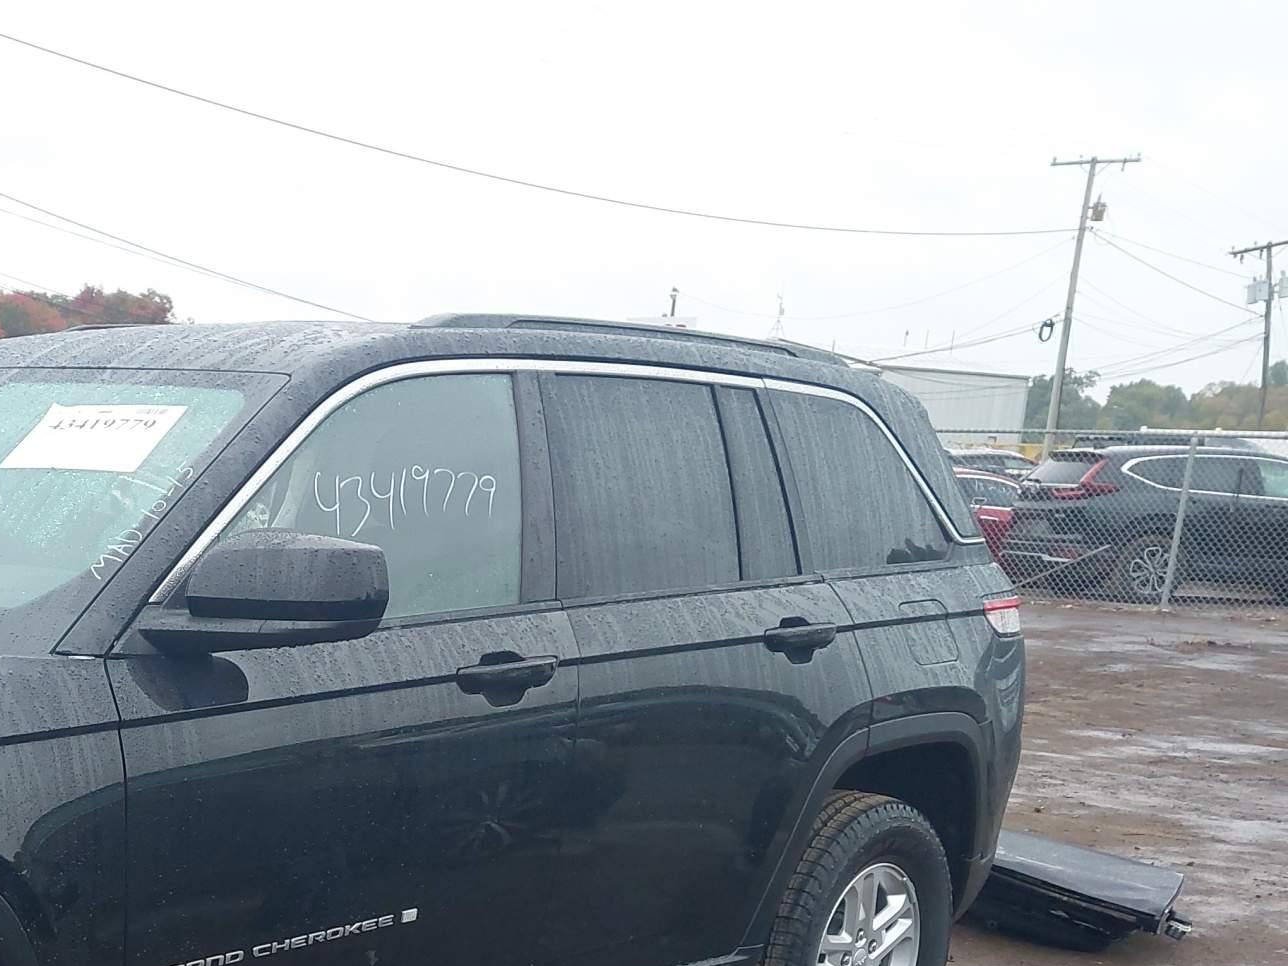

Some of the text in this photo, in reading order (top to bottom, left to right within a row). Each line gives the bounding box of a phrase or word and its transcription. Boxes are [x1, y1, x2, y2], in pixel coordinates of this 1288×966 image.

[49, 418, 158, 431] 43419779
[90, 529, 143, 580] MAD
[140, 461, 194, 520] 10-15
[314, 464, 497, 537] 43419779
[252, 914, 395, 958] CHEROKEE
